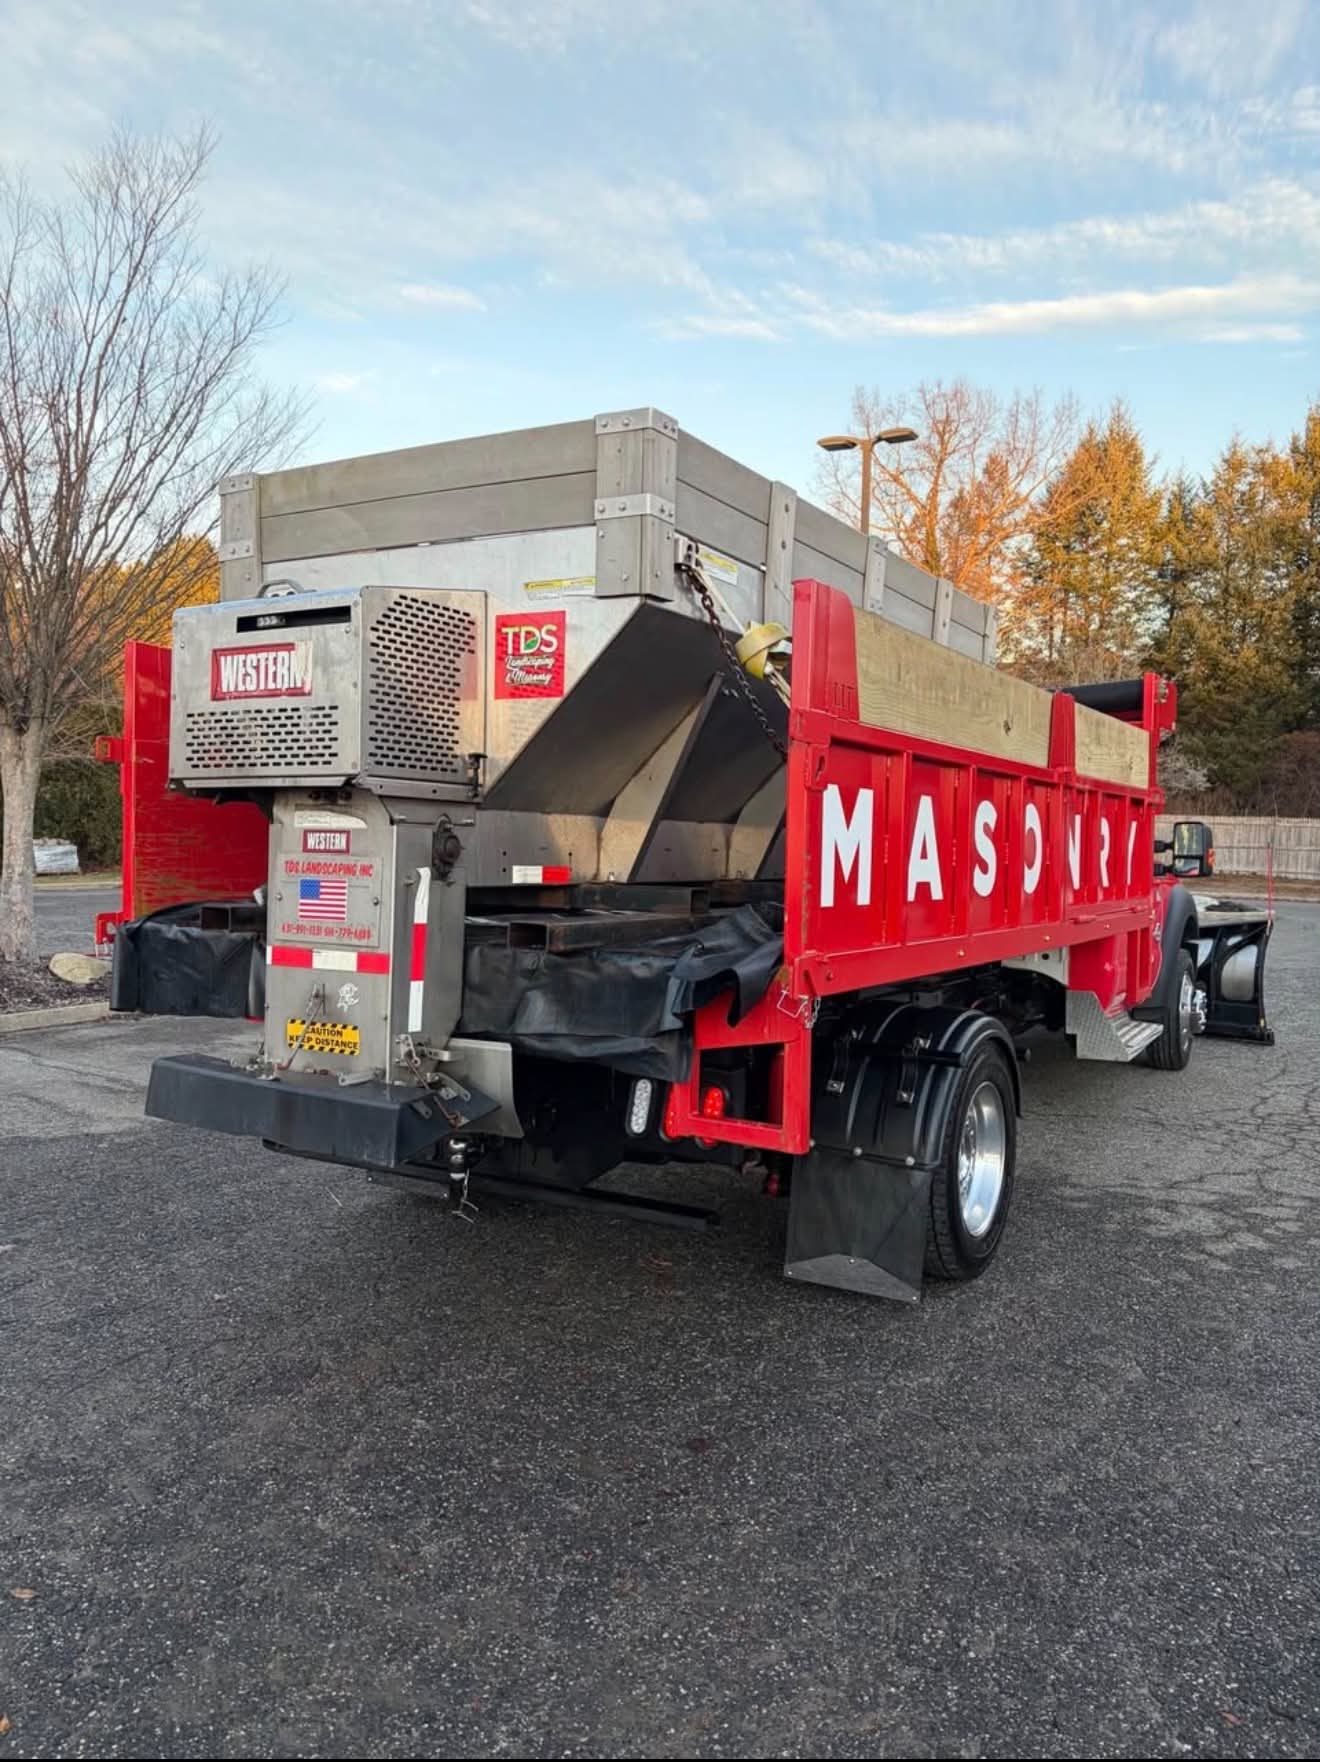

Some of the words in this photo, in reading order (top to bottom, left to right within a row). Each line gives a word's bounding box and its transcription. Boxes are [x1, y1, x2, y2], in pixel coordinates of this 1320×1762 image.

[501, 624, 559, 655] TDS
[220, 650, 304, 693] WESTERN
[307, 832, 347, 850] WESTERN
[300, 861, 358, 877] LANDSCAPING
[359, 864, 374, 877] INC
[315, 1037, 359, 1049] DISTANCE
